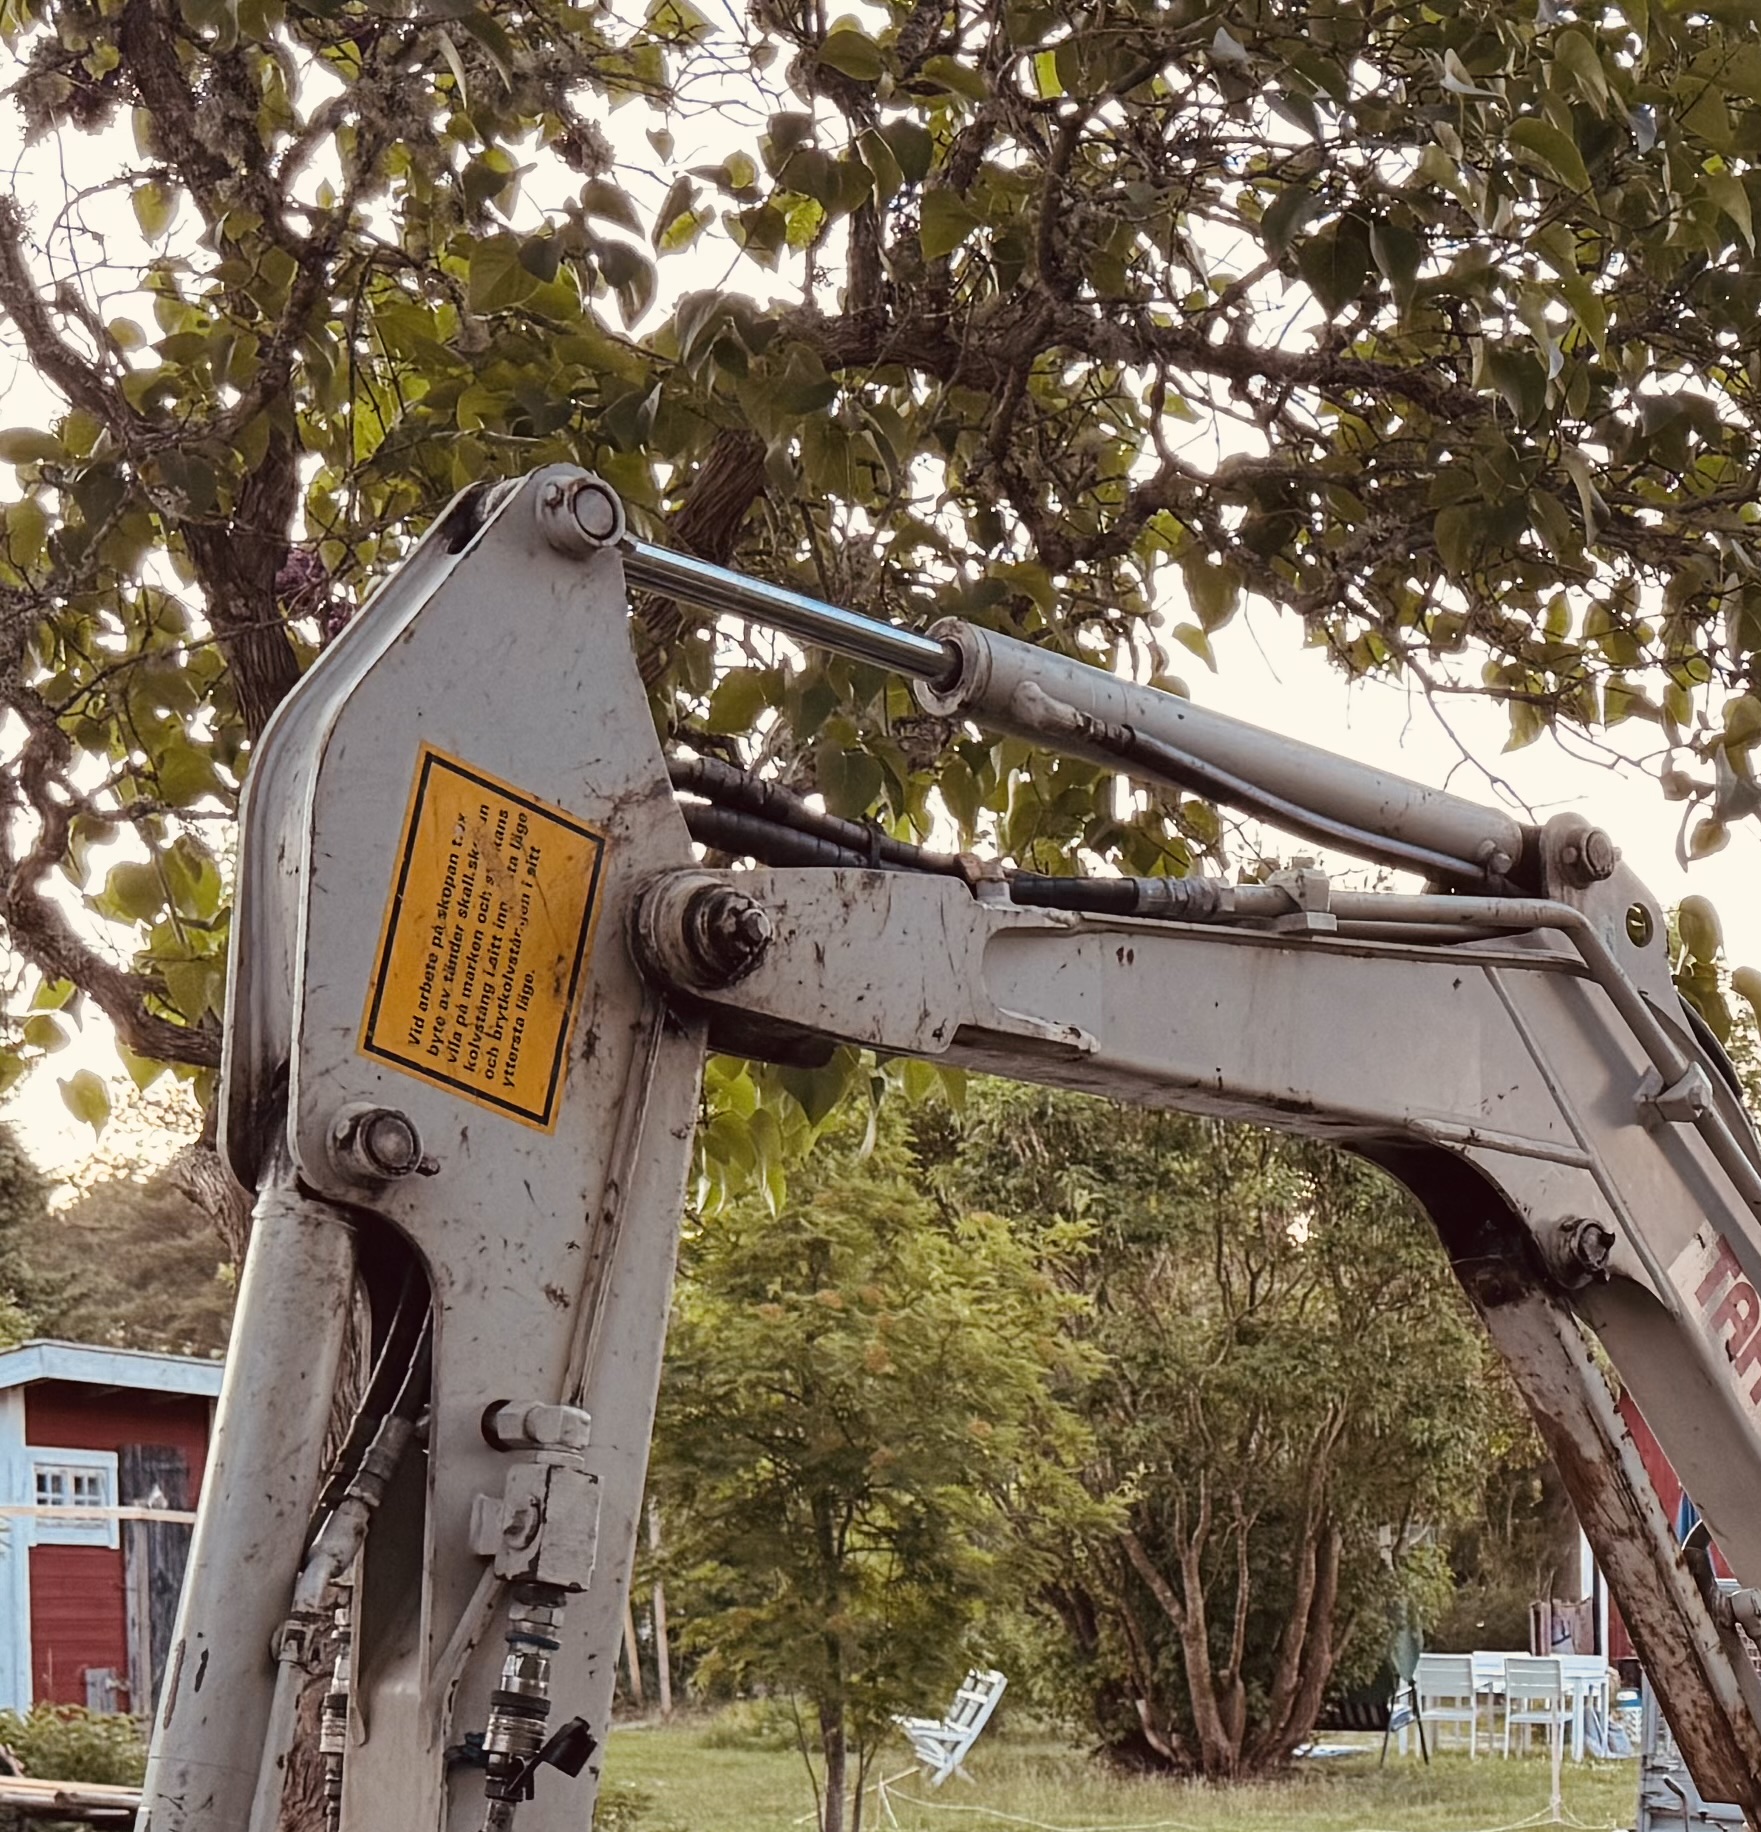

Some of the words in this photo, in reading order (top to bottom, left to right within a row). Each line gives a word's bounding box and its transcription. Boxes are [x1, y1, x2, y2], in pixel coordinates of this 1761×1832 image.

[436, 853, 459, 920] skopan
[432, 925, 446, 949] på
[443, 924, 464, 983] tänder
[463, 982, 495, 1072] kolvstång
[487, 935, 503, 966] sitt
[509, 813, 528, 850] läge
[485, 1047, 499, 1080] och
[525, 846, 541, 878] sitt
[418, 953, 438, 1012] arbete
[439, 988, 451, 1011] av
[447, 1031, 462, 1063] vila
[455, 1004, 468, 1028] på
[462, 930, 484, 998] marken
[478, 891, 492, 924] och
[408, 1015, 425, 1045] Vid
[426, 1016, 446, 1056] byte
[503, 1017, 525, 1087] yttersta
